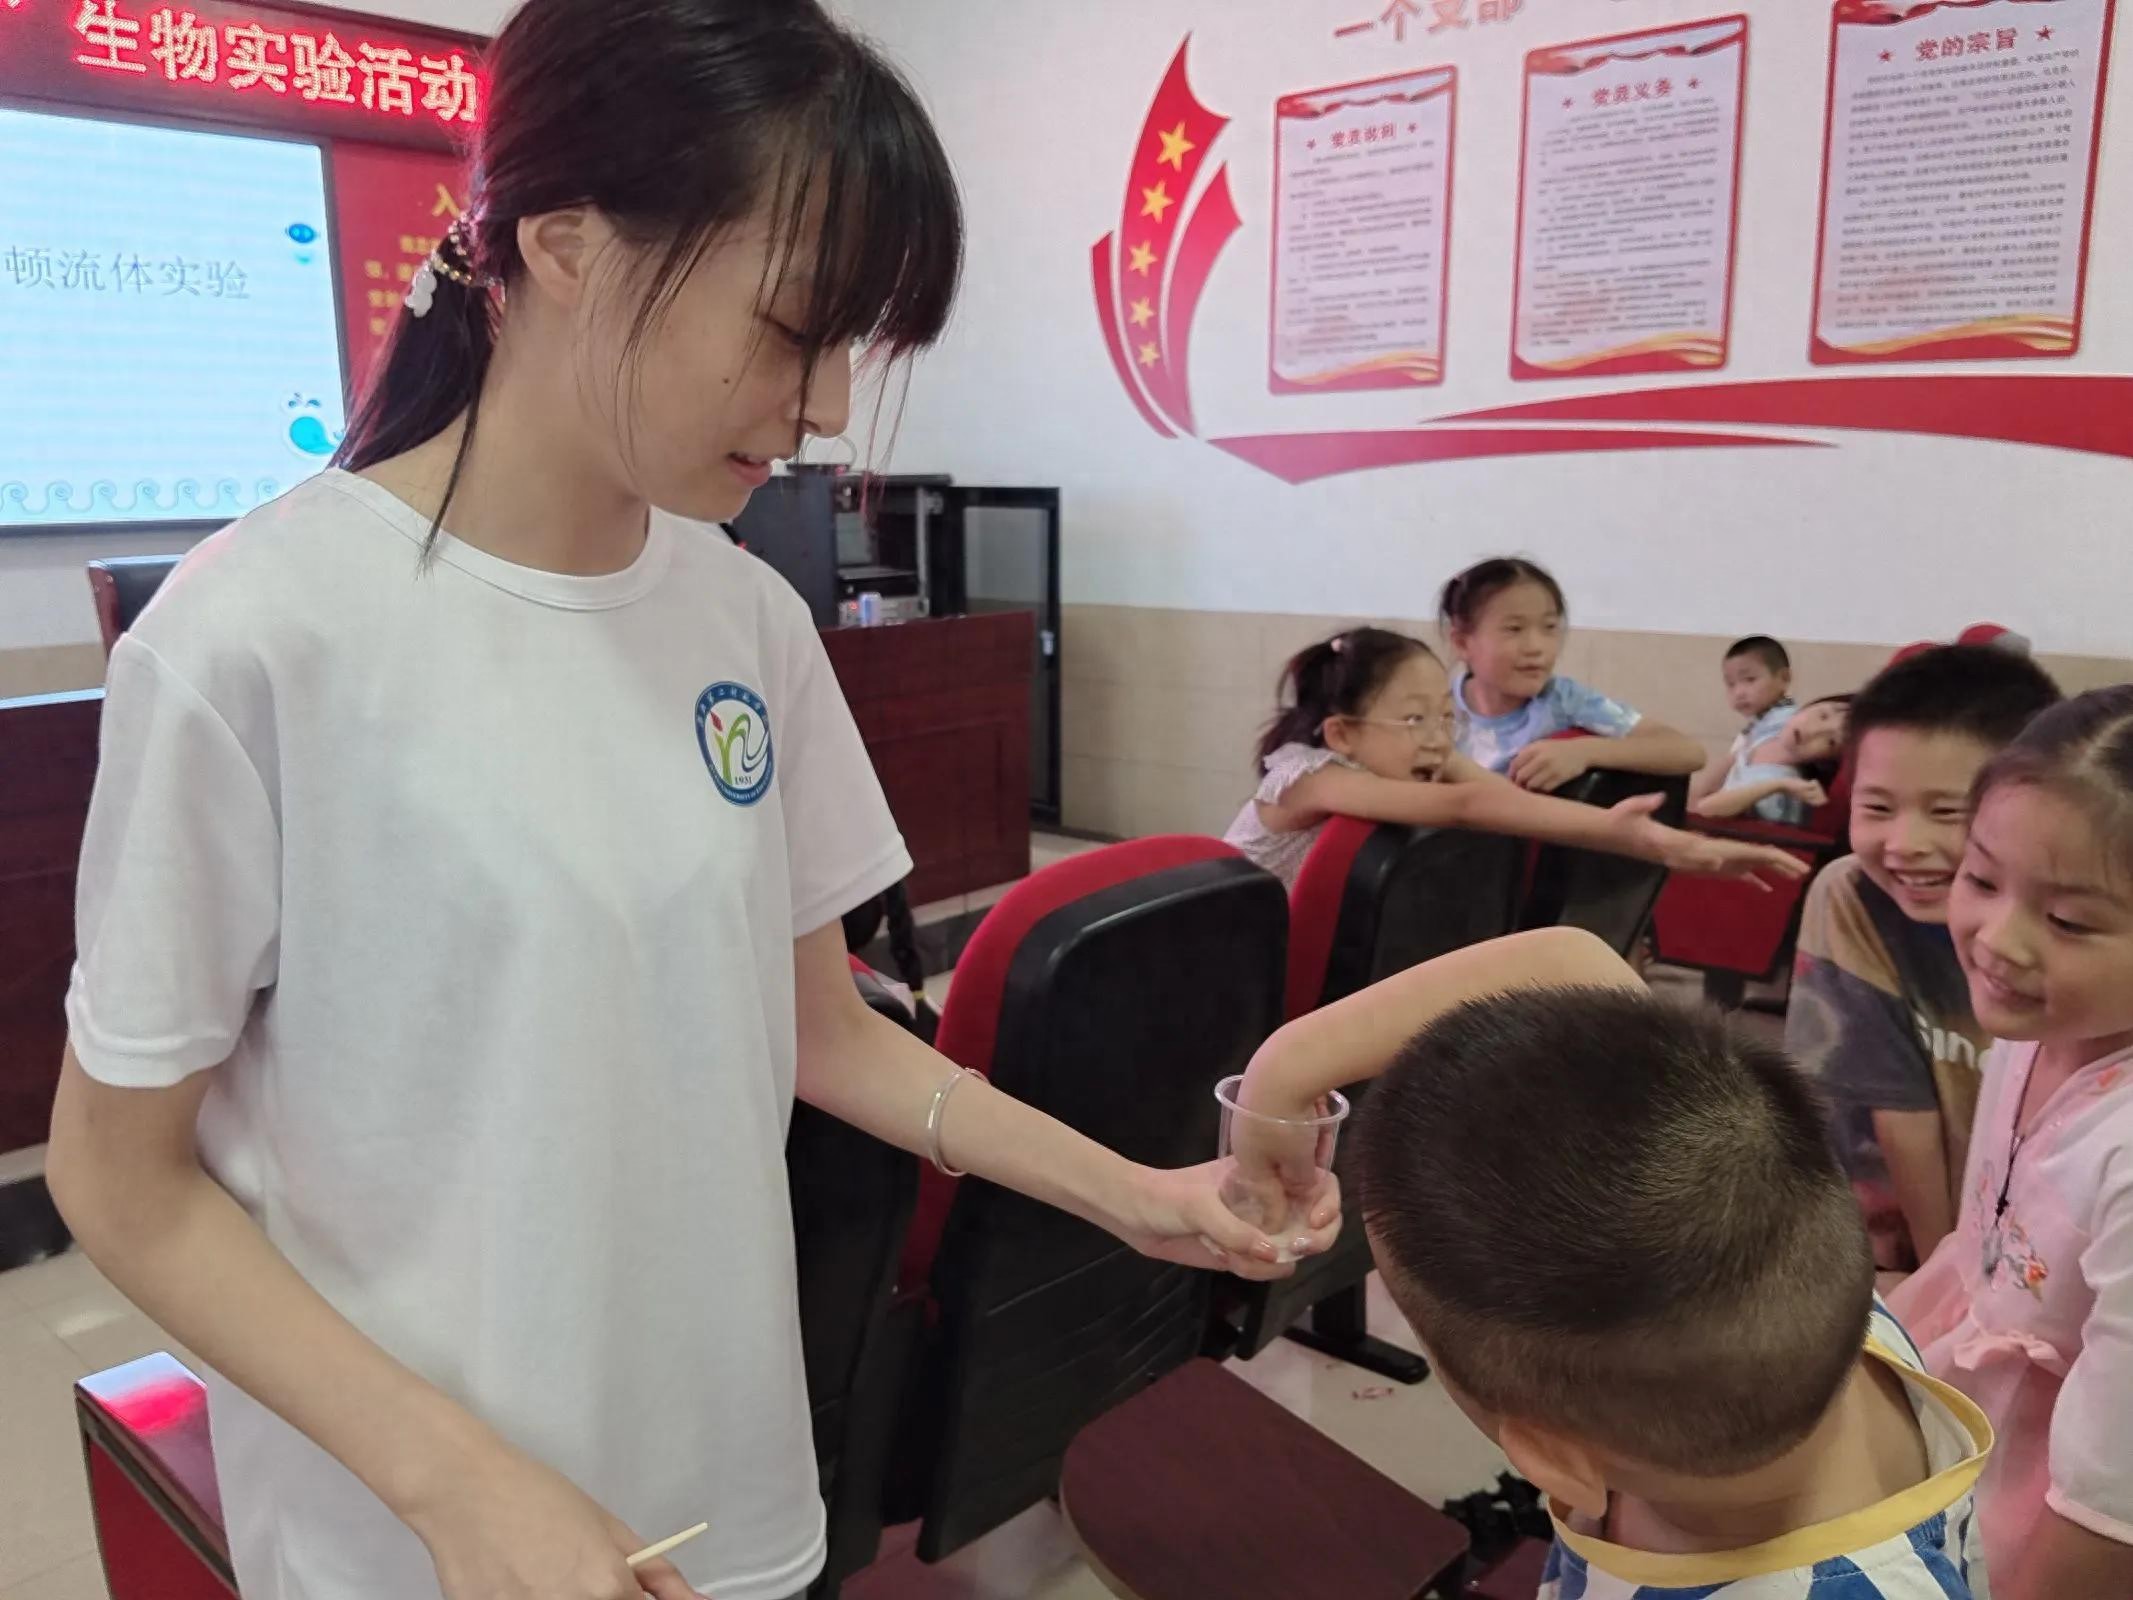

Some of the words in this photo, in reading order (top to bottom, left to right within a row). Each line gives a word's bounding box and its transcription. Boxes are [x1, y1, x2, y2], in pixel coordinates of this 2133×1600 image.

[75, 0, 477, 122] 生物实验活动
[1915, 27, 2017, 61] 党的宗旨
[4, 245, 250, 299] 顿流体实验
